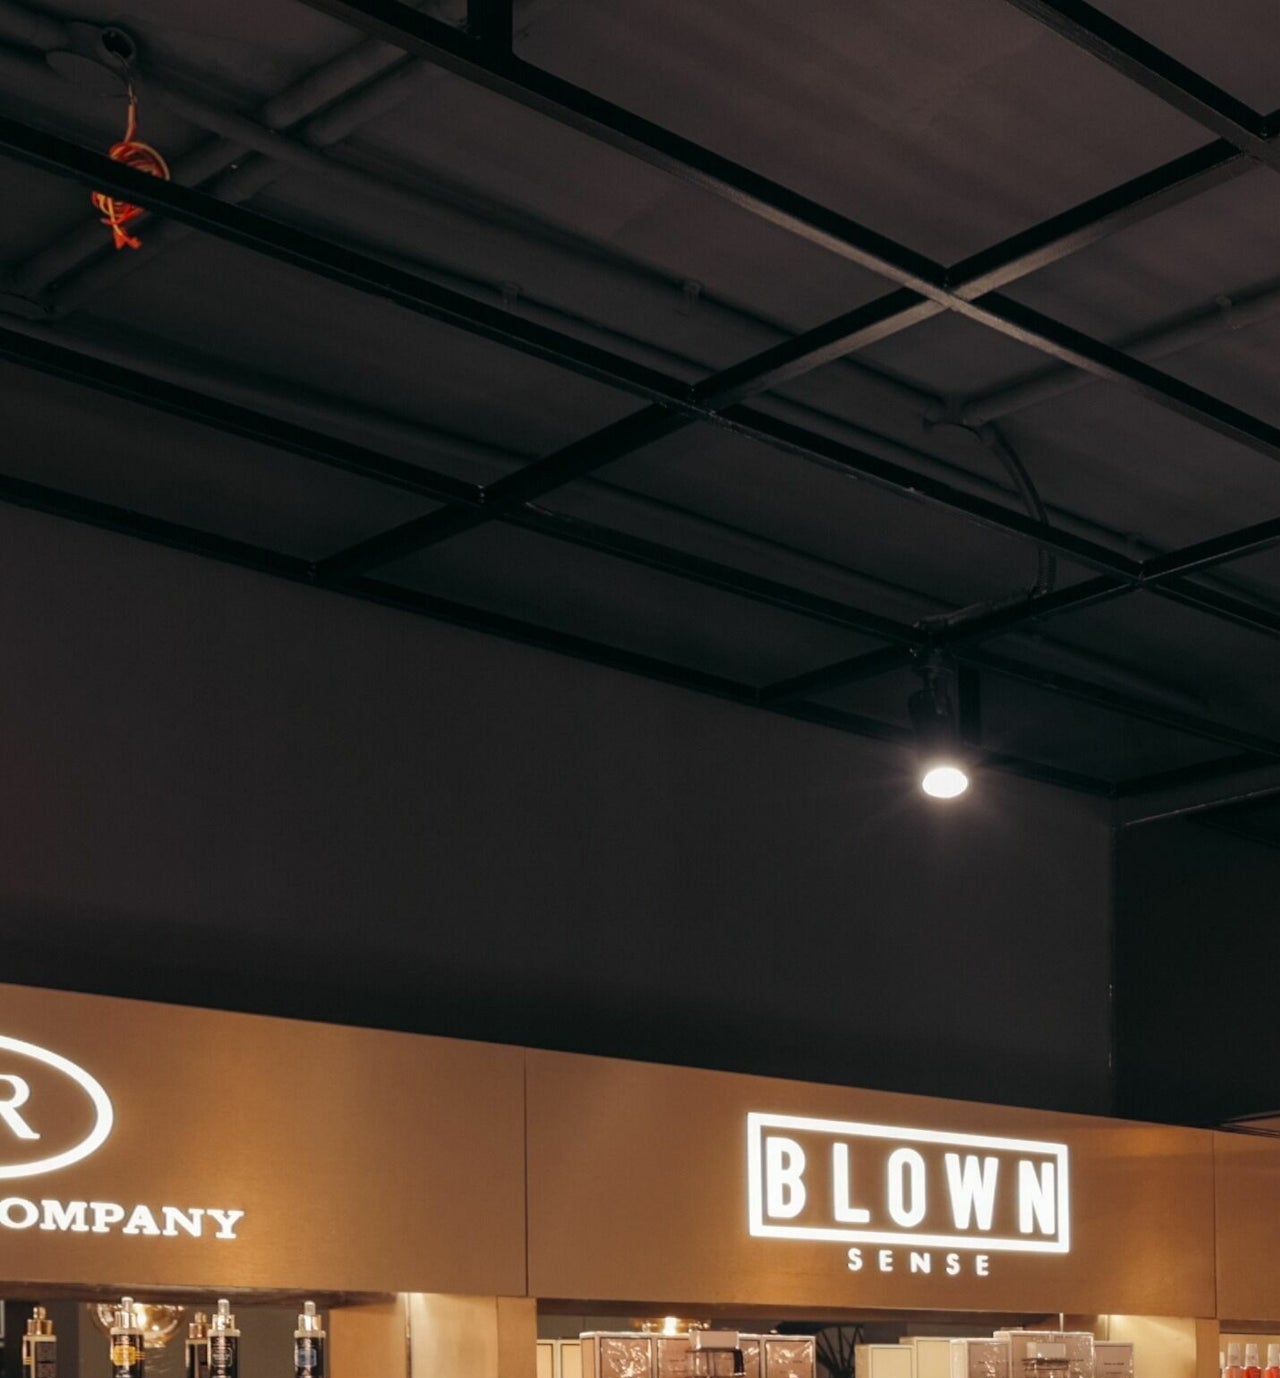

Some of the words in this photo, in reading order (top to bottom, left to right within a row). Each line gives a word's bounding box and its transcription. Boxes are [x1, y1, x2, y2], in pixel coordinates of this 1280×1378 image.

[765, 1136, 1056, 1235] BLOWN
[0, 1197, 245, 1239] OMPANY
[847, 1247, 991, 1276] SENSE
